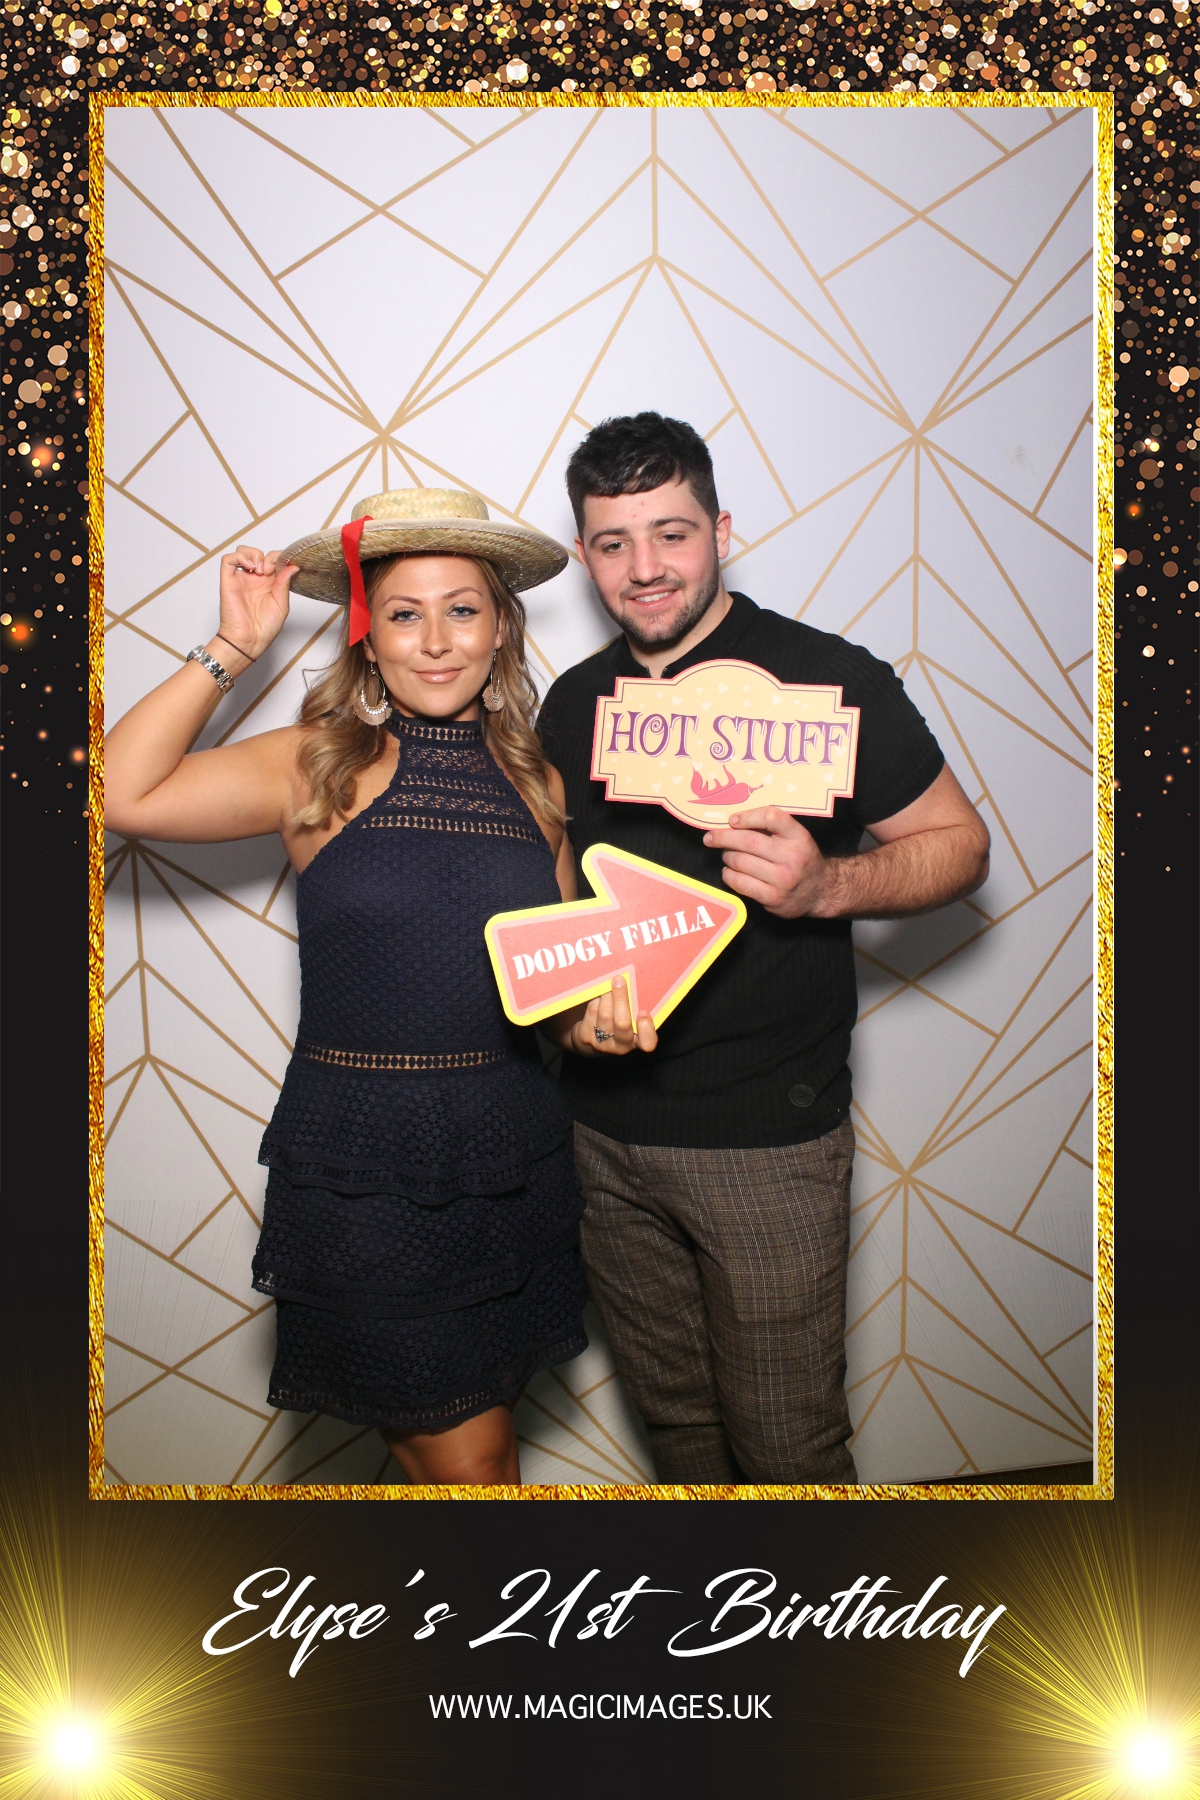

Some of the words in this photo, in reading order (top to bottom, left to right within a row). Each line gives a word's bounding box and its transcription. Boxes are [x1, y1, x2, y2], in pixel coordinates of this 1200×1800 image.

[606, 711, 697, 757] HOT
[709, 714, 849, 765] STUFF
[512, 931, 611, 980] DODGY
[620, 905, 715, 950] FELLA
